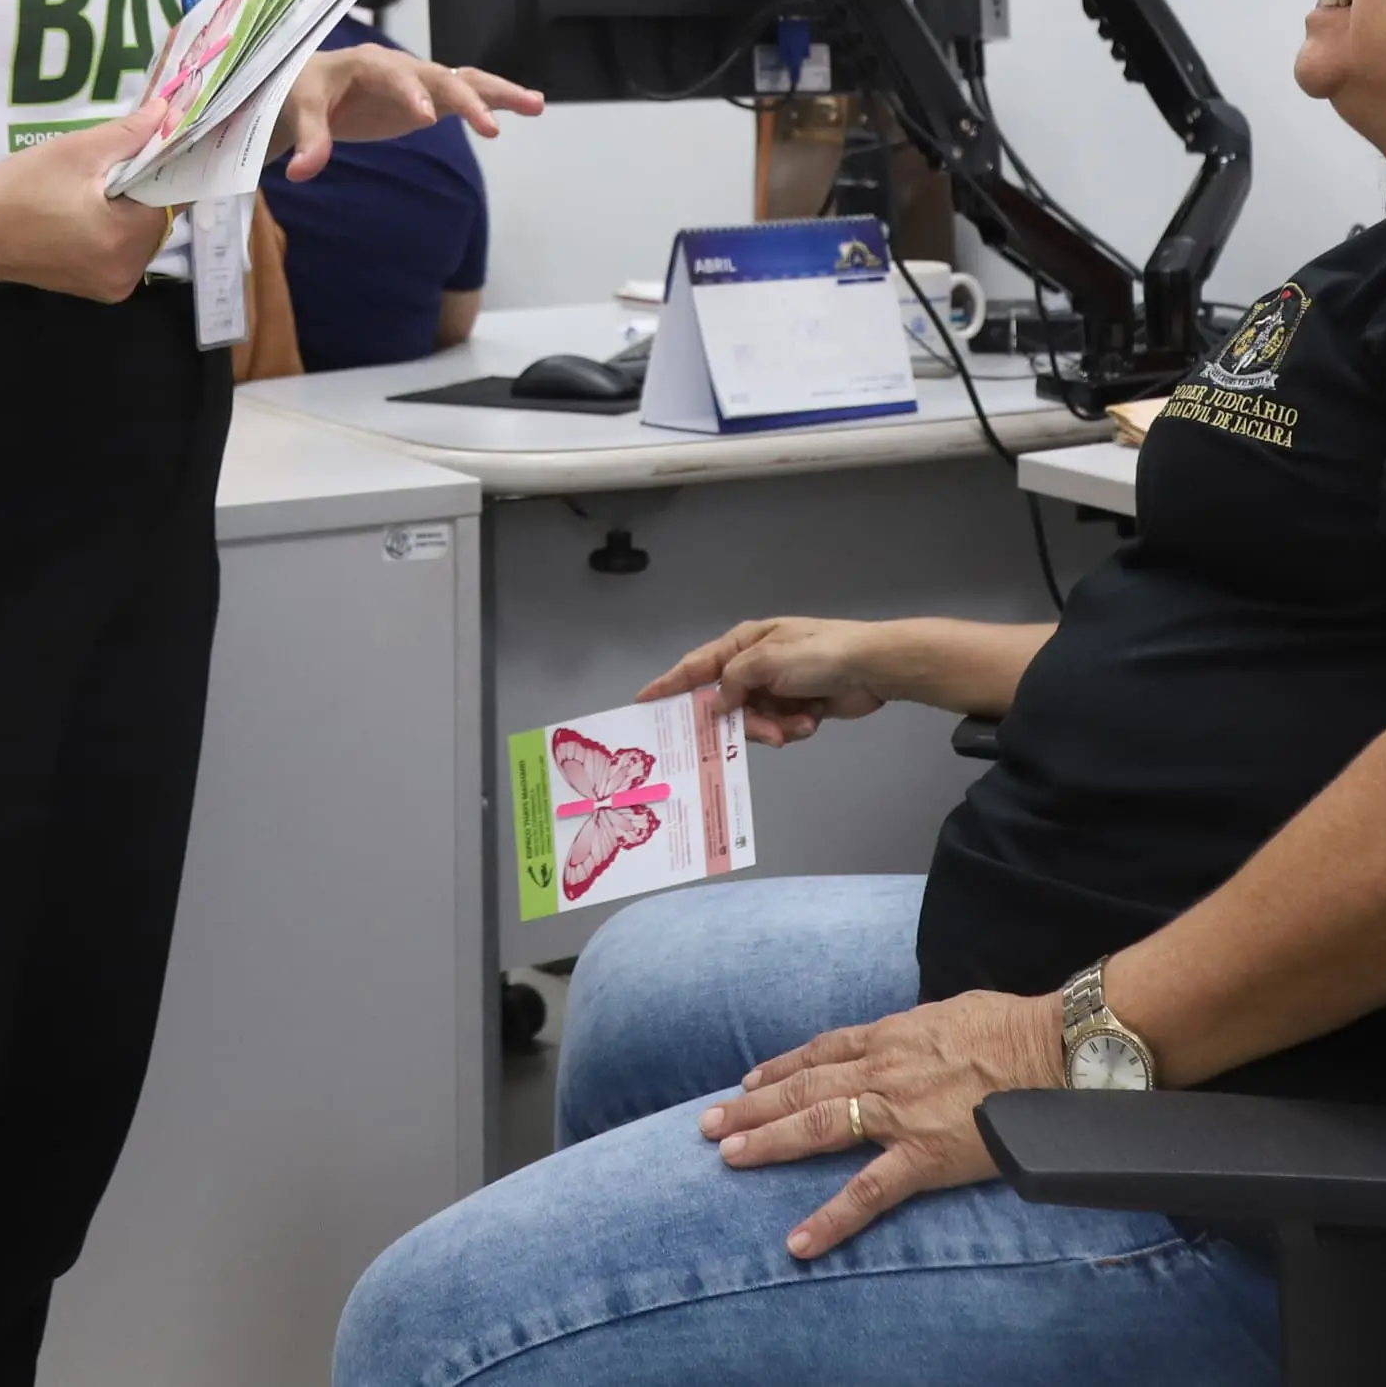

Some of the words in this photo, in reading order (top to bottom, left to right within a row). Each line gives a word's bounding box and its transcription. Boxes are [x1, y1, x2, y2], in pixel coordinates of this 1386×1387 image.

[694, 257, 737, 274] ABRIL
[1174, 383, 1209, 402] PODER
[1205, 388, 1299, 427] JUDICÁRIO
[1210, 409, 1234, 431] DE
[1230, 415, 1293, 448] JACIARA
